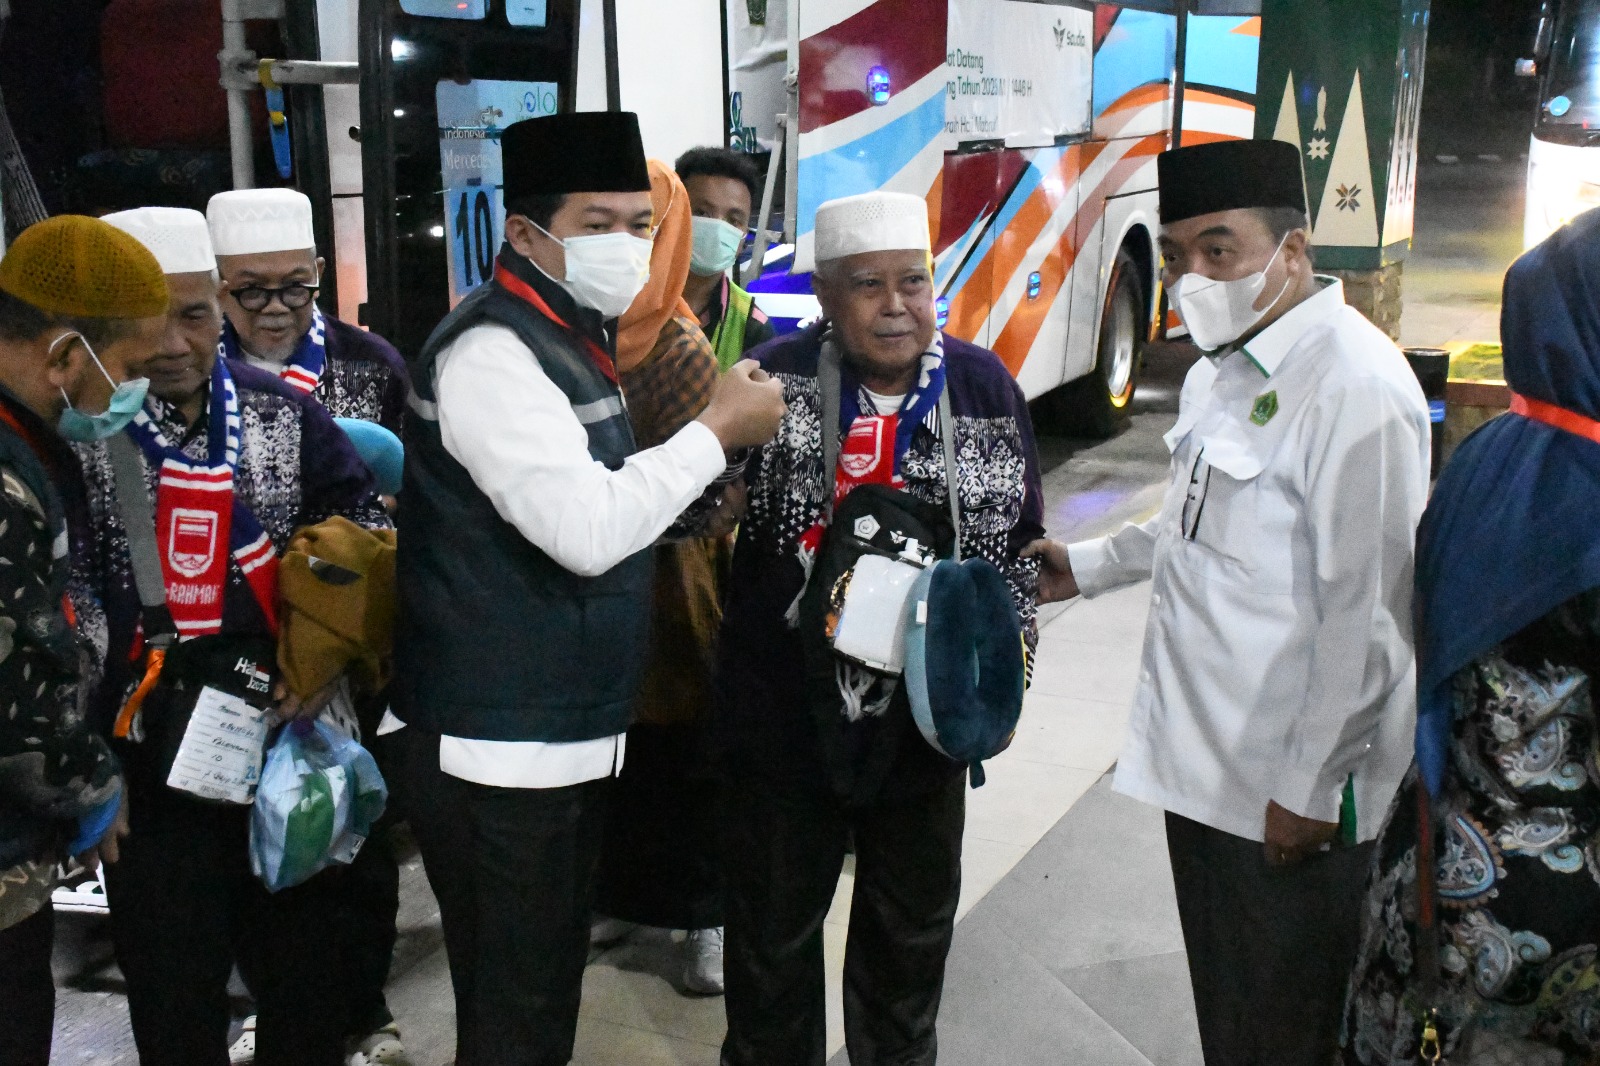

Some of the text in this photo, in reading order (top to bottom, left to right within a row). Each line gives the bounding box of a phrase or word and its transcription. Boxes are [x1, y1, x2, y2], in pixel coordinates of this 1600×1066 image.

[956, 48, 984, 74] Datang
[957, 76, 980, 95] Tahun
[455, 191, 494, 286] 10
